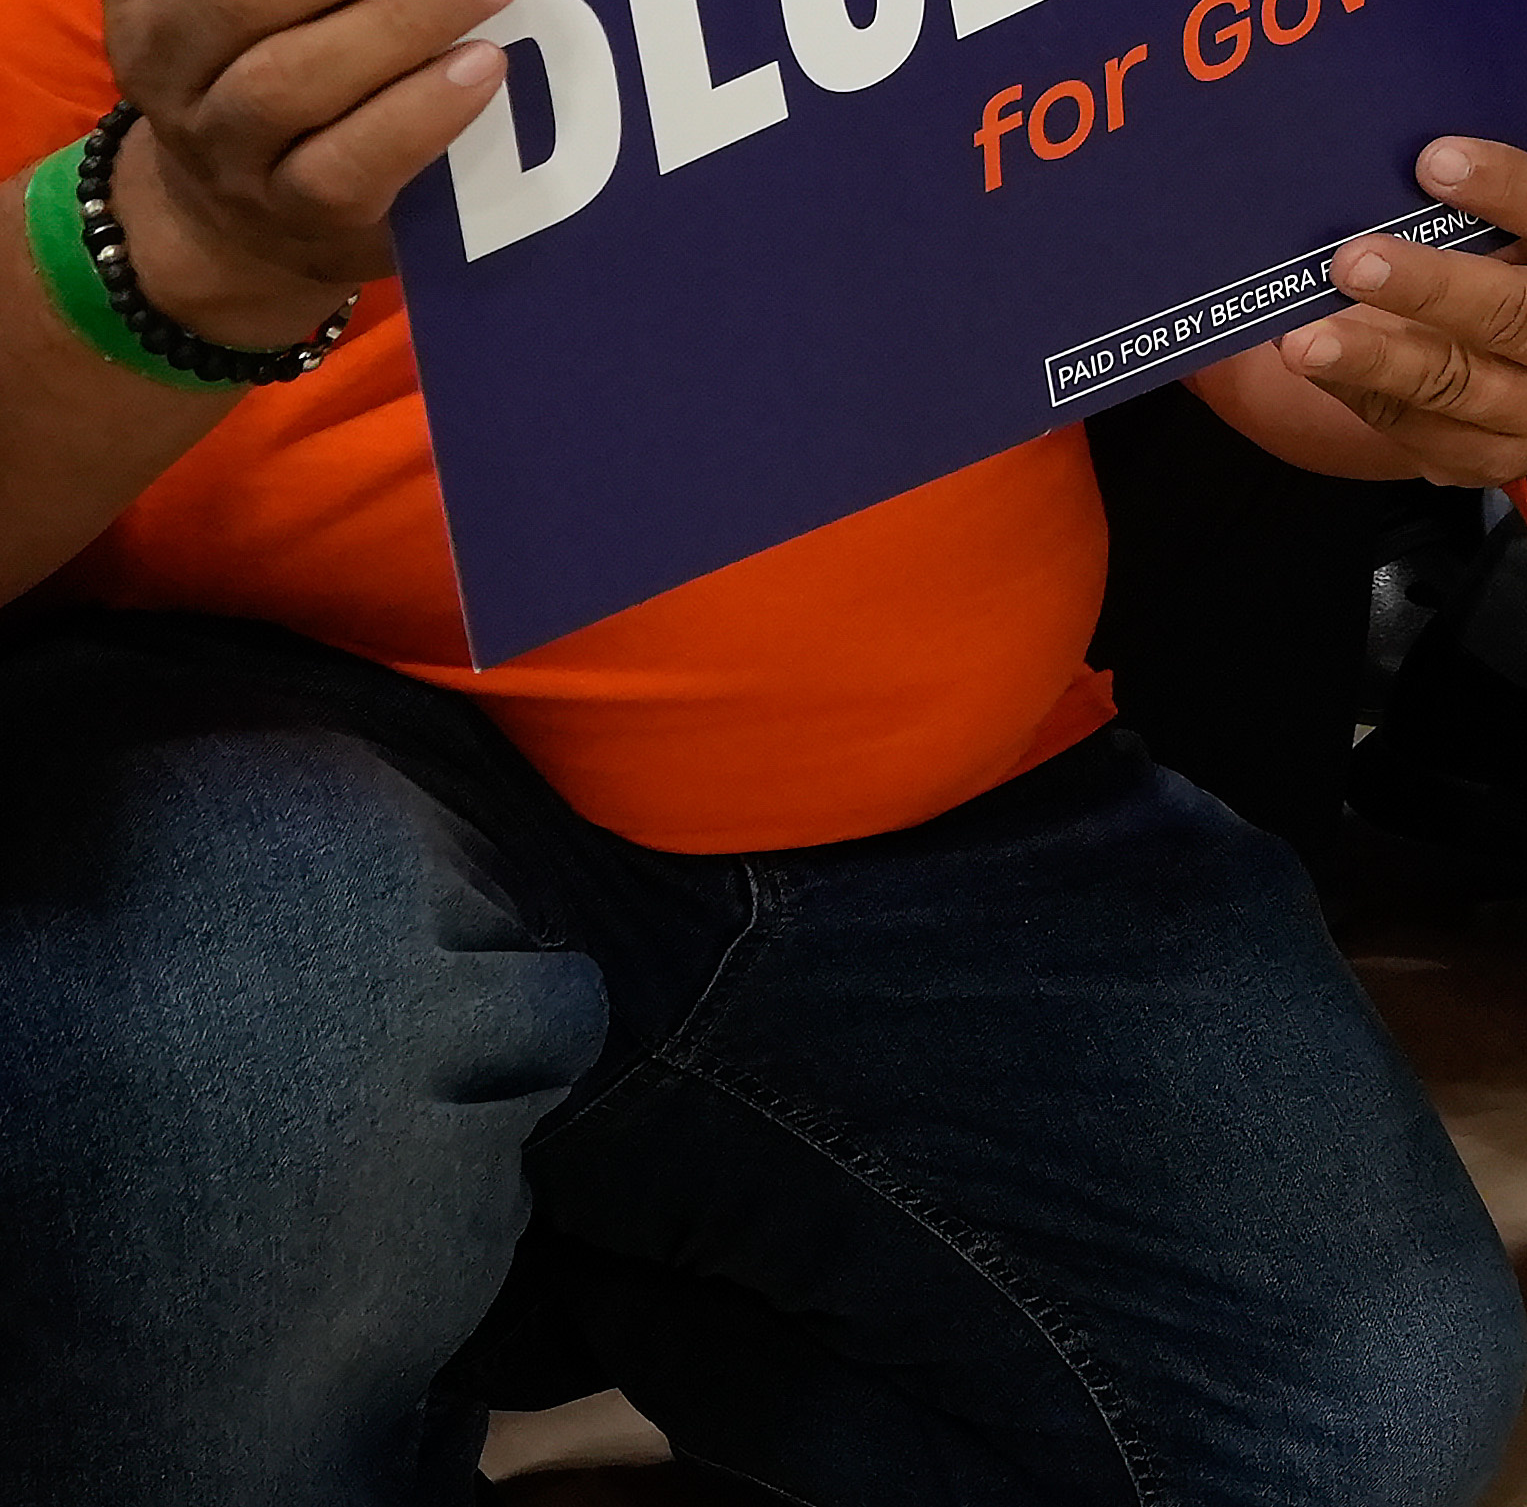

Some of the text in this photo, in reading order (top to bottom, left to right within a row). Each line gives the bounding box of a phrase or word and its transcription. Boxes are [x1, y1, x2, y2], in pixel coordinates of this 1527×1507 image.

[973, 44, 1154, 192] for
[1058, 350, 1114, 390] PAID
[1120, 329, 1171, 364] FOR
[1174, 311, 1204, 344] BY
[1210, 268, 1317, 327] BECERRA
